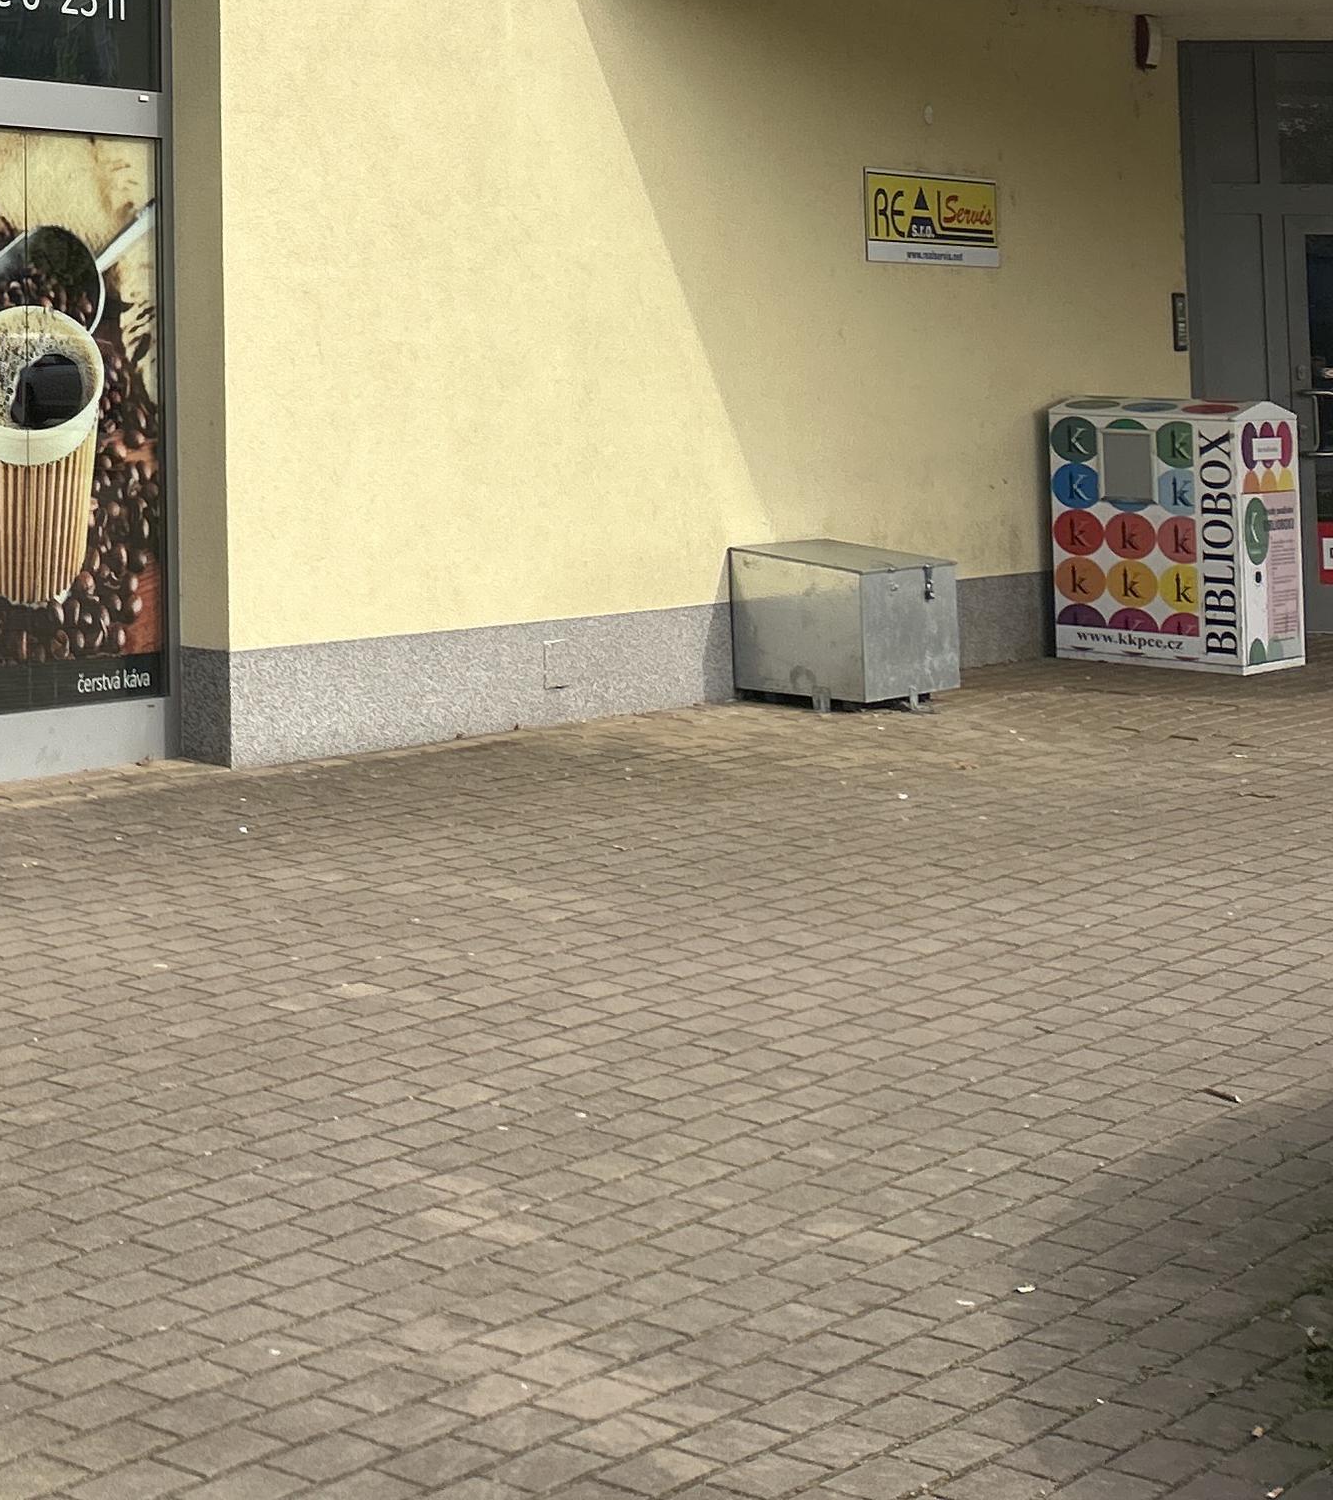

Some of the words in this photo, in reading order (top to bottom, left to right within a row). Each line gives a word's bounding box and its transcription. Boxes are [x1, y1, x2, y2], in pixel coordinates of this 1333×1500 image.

[874, 186, 969, 238] REAL
[943, 195, 993, 226] Servis
[1199, 429, 1239, 658] BIBLIOBOX
[77, 669, 122, 694] čerstvá
[123, 668, 151, 689] káva
